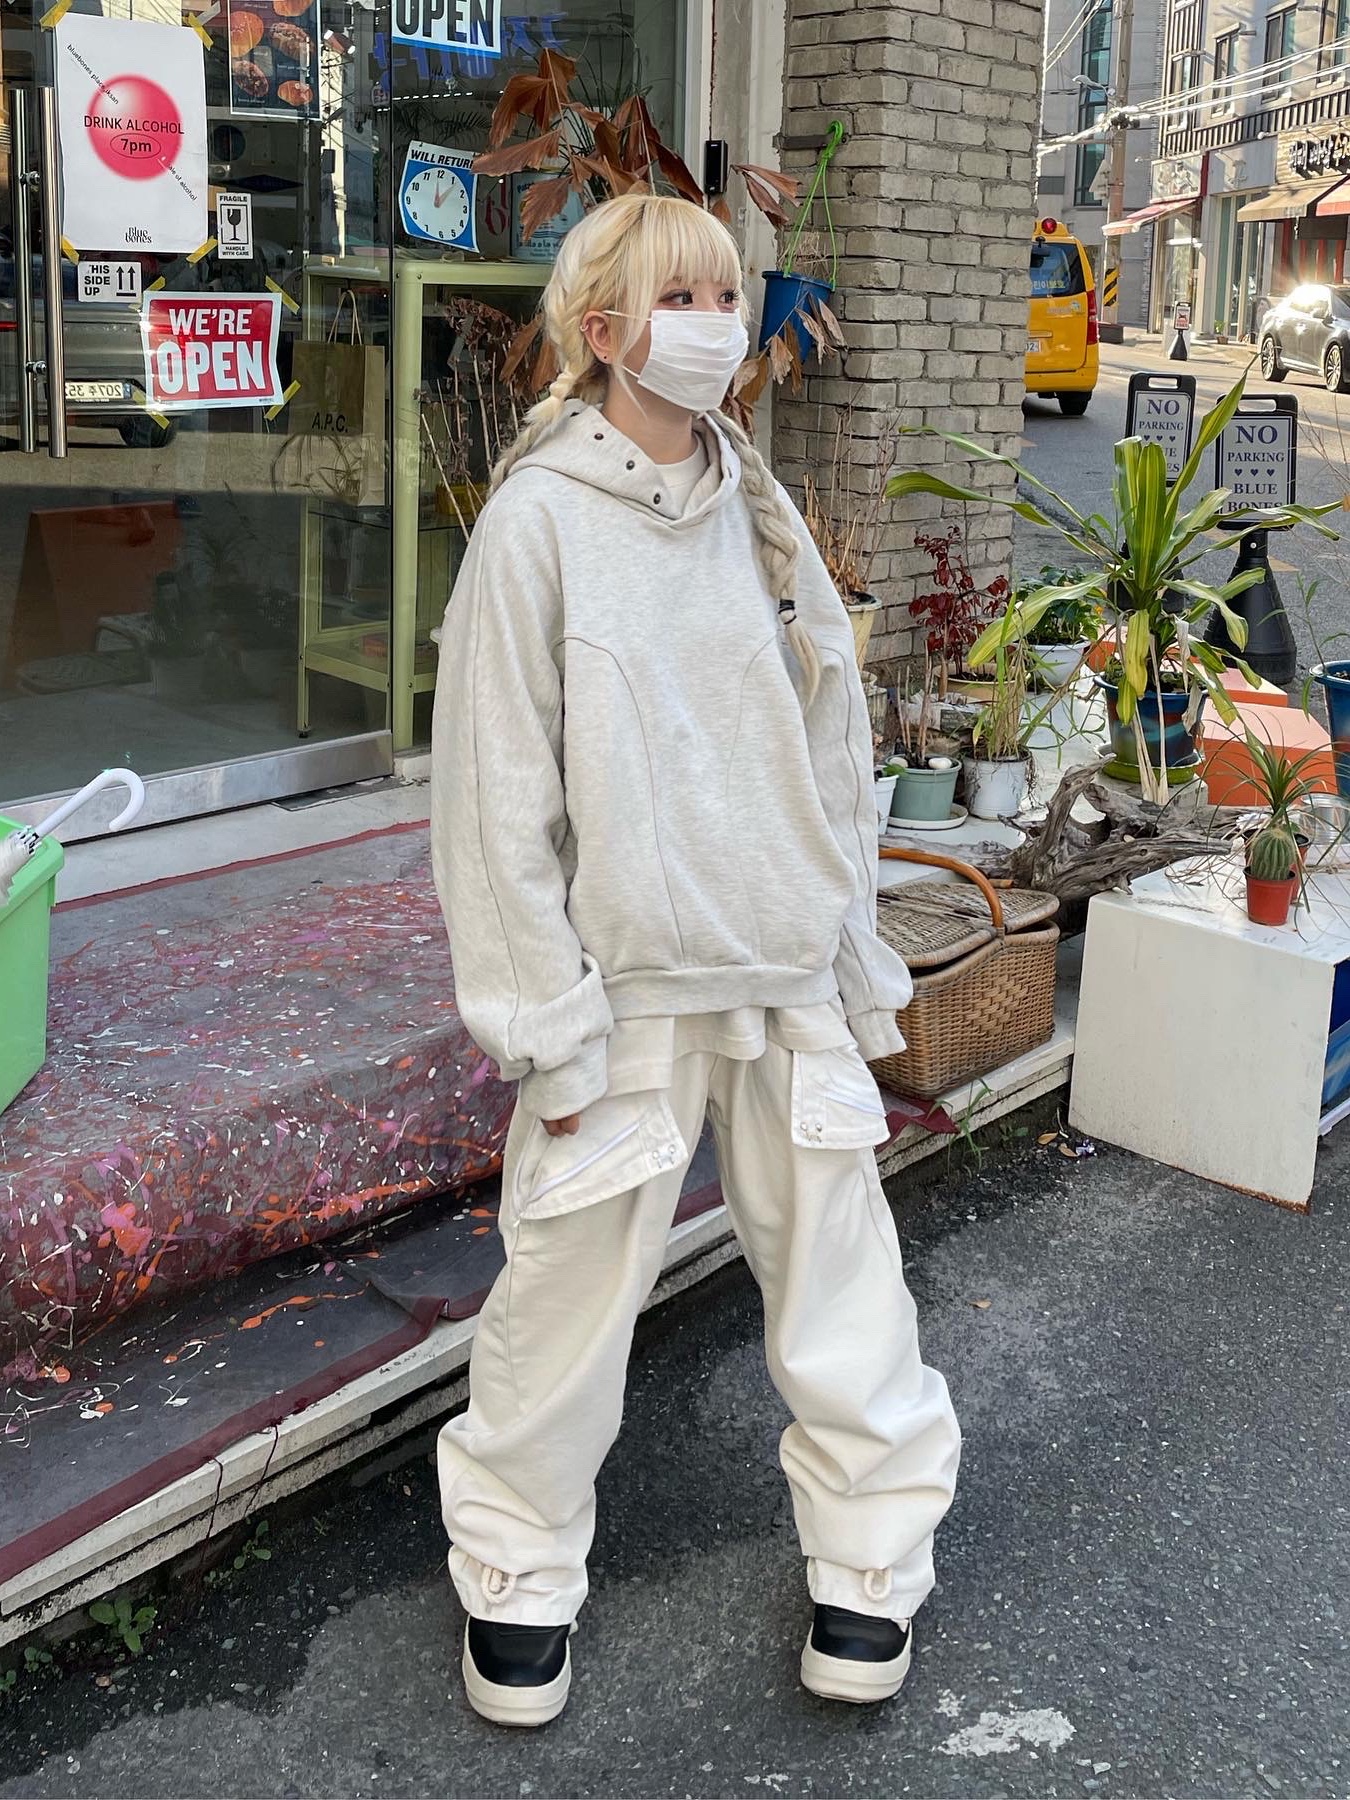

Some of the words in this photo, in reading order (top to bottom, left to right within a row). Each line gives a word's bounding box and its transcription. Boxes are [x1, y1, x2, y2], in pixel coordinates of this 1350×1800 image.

[396, 0, 495, 47] OPEN
[67, 44, 93, 75] bluebones
[84, 115, 123, 130] DRINK
[126, 120, 184, 134] ALCOHOL
[120, 139, 152, 155] 7pm
[411, 149, 436, 164] WILL
[423, 172, 431, 181] 11
[437, 170, 445, 179] 12
[451, 176, 455, 185] 1
[180, 181, 198, 201] alcohol
[411, 182, 420, 192] 10
[219, 195, 248, 203] FRAGILE
[460, 189, 465, 199] 2
[405, 196, 411, 205] 9
[463, 205, 468, 214] 3
[412, 211, 418, 220] 8
[459, 219, 465, 228] 4
[128, 226, 149, 237] Blue
[438, 230, 444, 239] 6
[450, 229, 456, 238] 5
[124, 232, 152, 244] bones
[84, 275, 111, 286] SIDE
[84, 286, 100, 296] UP
[156, 340, 266, 395] OPEN
[1147, 399, 1180, 416] NO
[311, 411, 349, 433] A.P.C.
[1138, 420, 1184, 432] PARKING
[1235, 424, 1279, 445] NO
[1227, 451, 1285, 463] PARKING
[1233, 483, 1278, 495] BLUE
